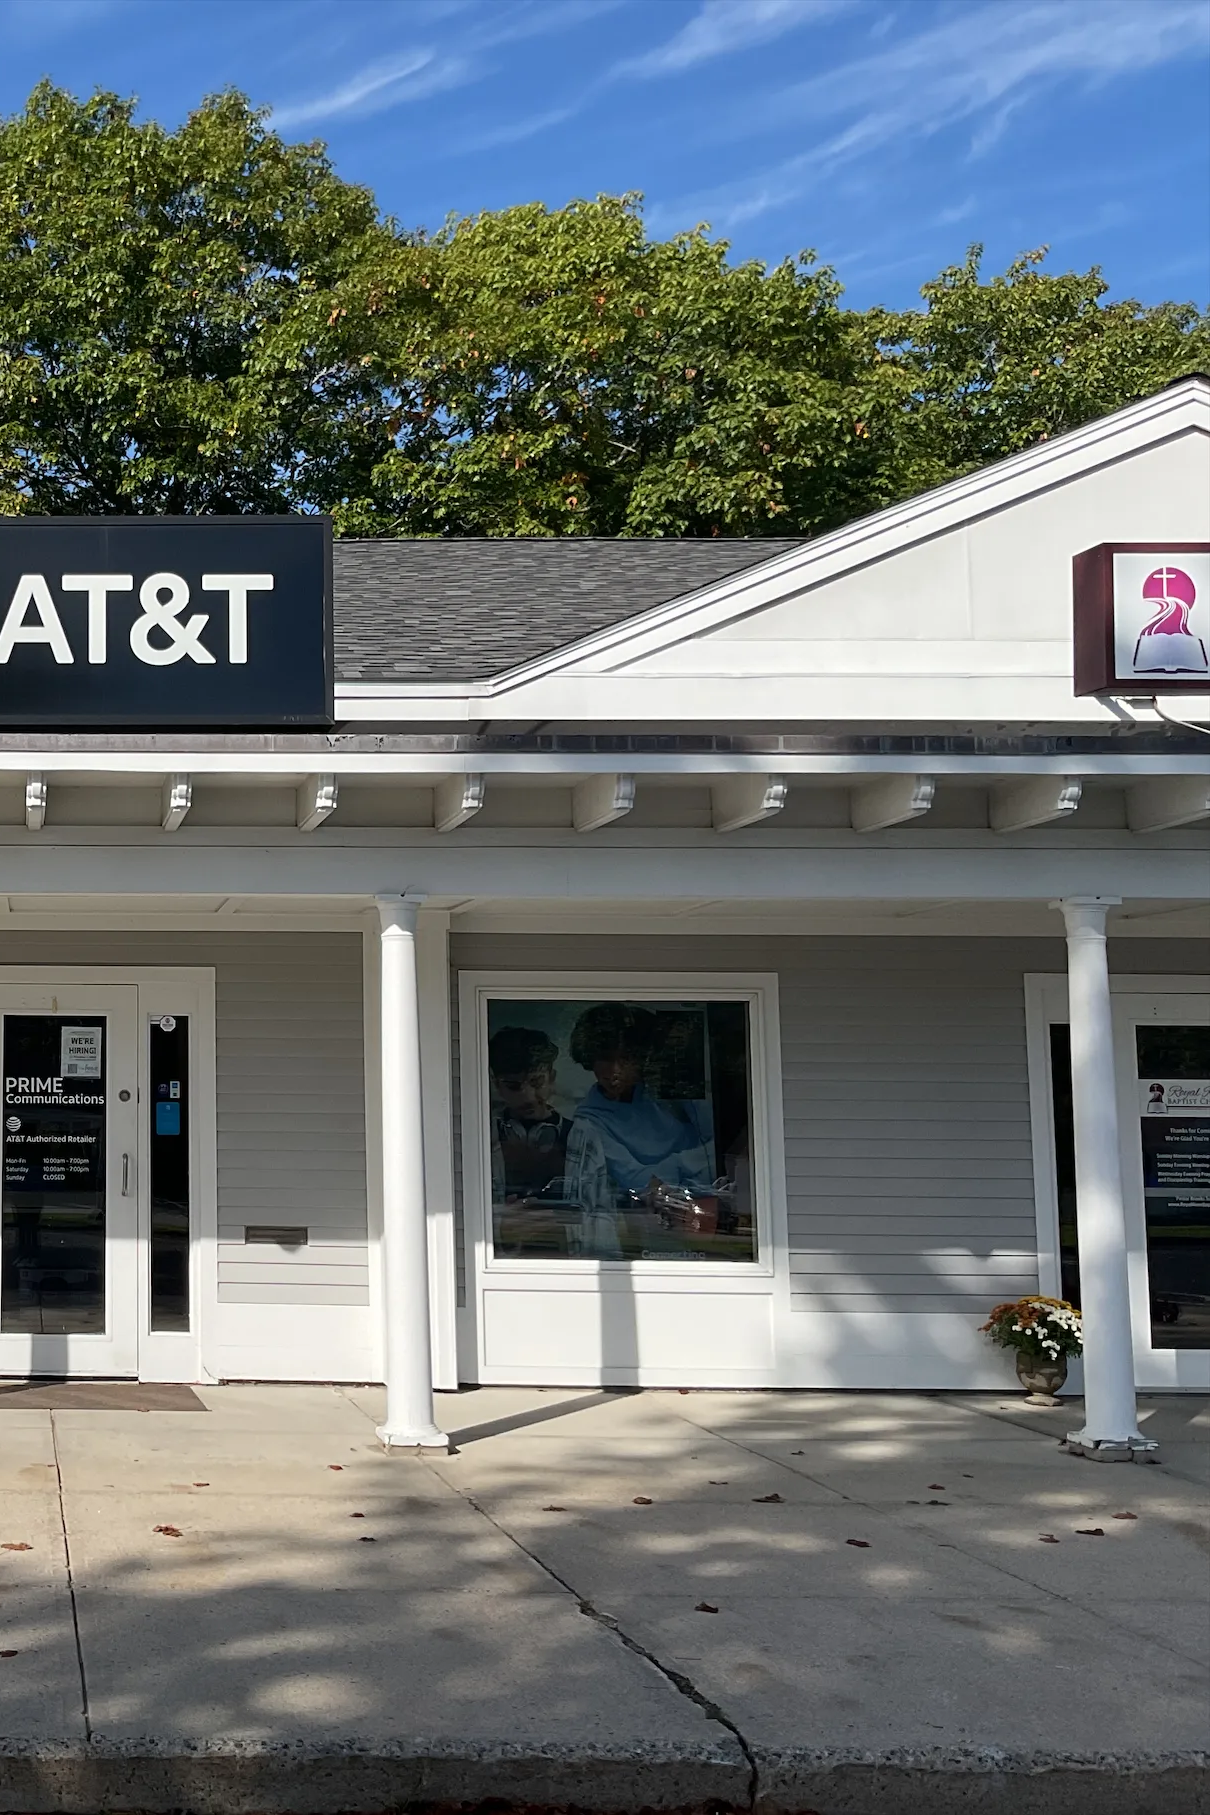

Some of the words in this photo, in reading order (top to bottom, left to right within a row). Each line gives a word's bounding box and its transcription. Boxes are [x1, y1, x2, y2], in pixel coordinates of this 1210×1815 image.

[71, 1037, 94, 1045] WE'RE
[5, 1077, 64, 1093] PRIME
[1168, 1085, 1201, 1100] Royal
[5, 1093, 105, 1104] Communications
[6, 1135, 25, 1143] AT&T
[26, 1135, 67, 1143] Authorized
[67, 1135, 96, 1143] Retailer
[6, 1174, 25, 1182] Sunday
